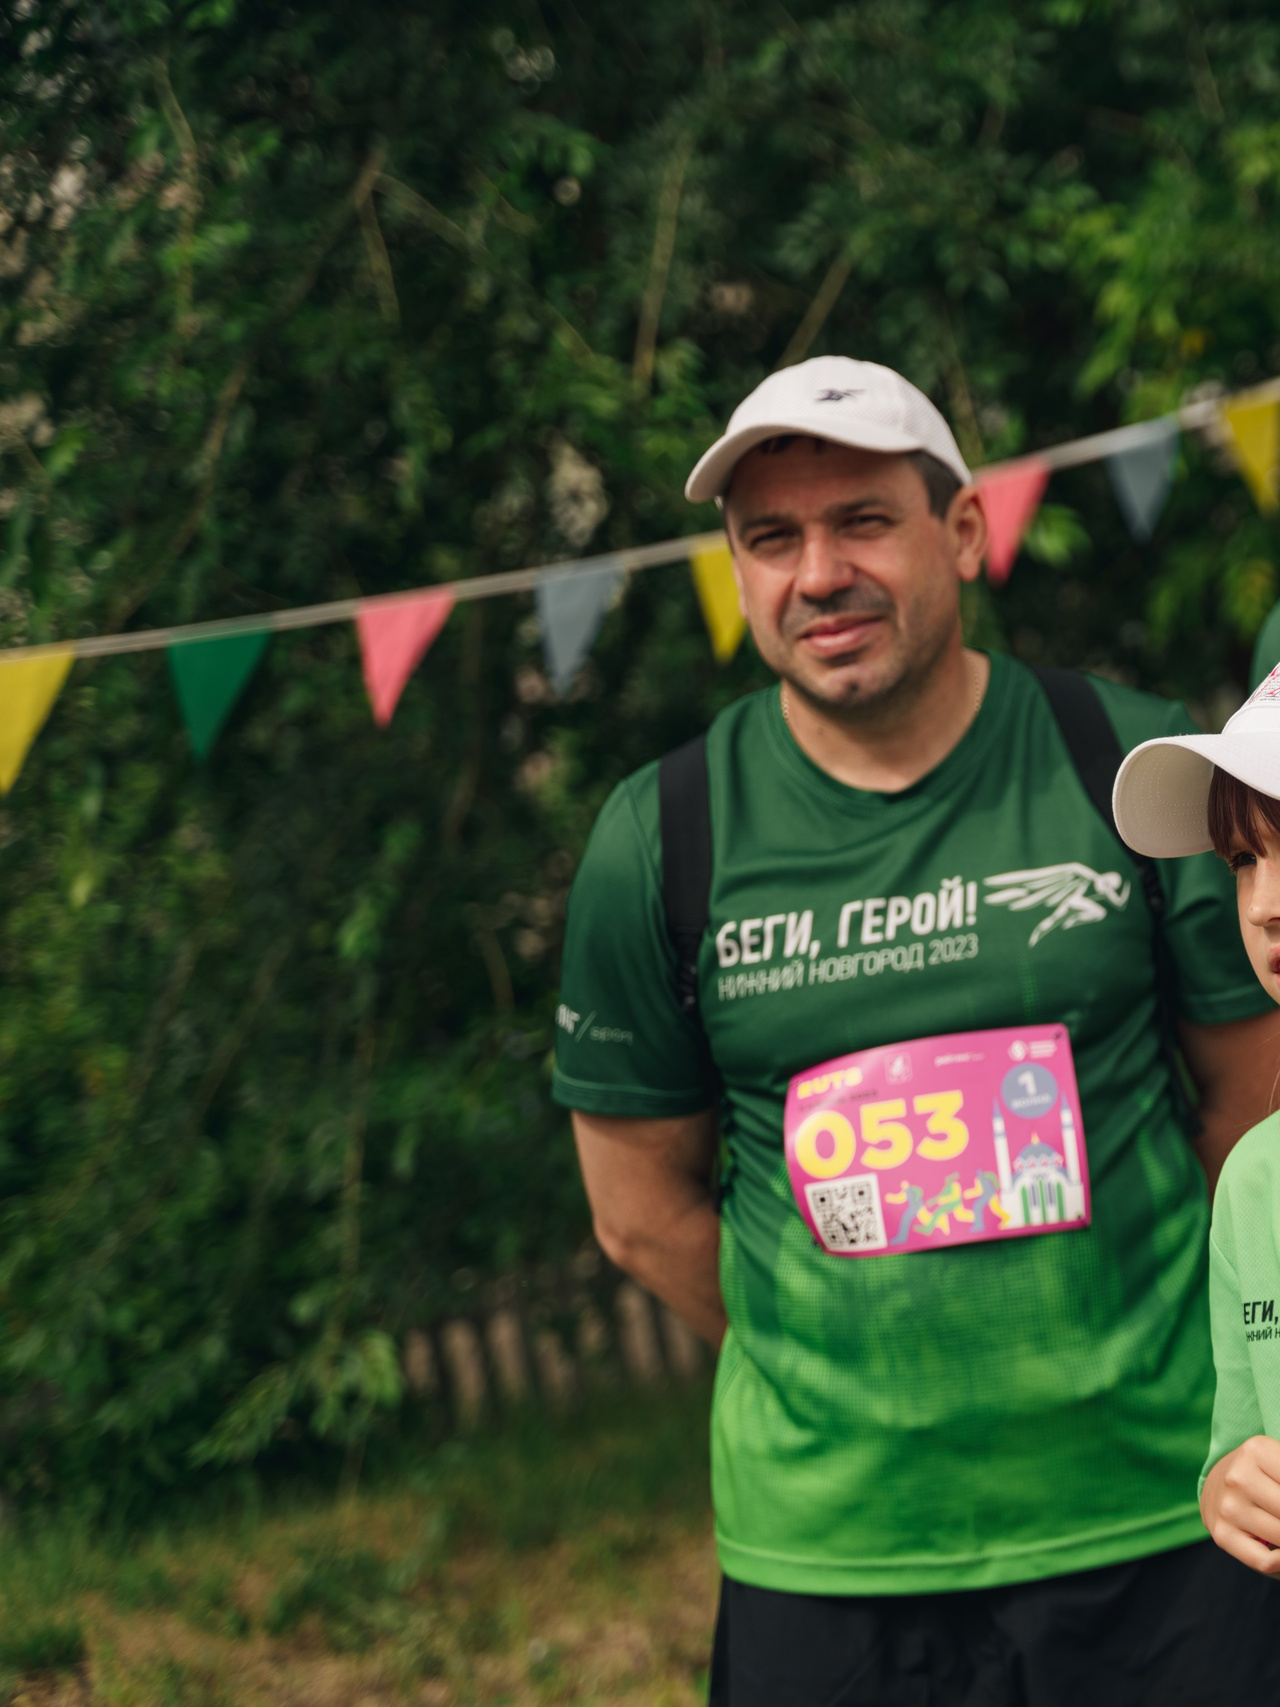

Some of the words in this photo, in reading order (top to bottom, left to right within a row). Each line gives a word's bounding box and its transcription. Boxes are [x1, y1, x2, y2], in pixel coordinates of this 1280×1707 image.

[716, 909, 821, 968] БЕГИ,
[837, 875, 977, 949] ГЕРОЙ!
[717, 959, 804, 1001] НИЖНИЙ
[808, 942, 925, 985] НОВГОРОД
[928, 932, 979, 965] 2023
[1018, 1070, 1037, 1097] 1
[795, 1090, 969, 1180] 053
[1243, 1299, 1279, 1325] ЕГИ,
[1245, 1326, 1273, 1343] ЖНИЙ
